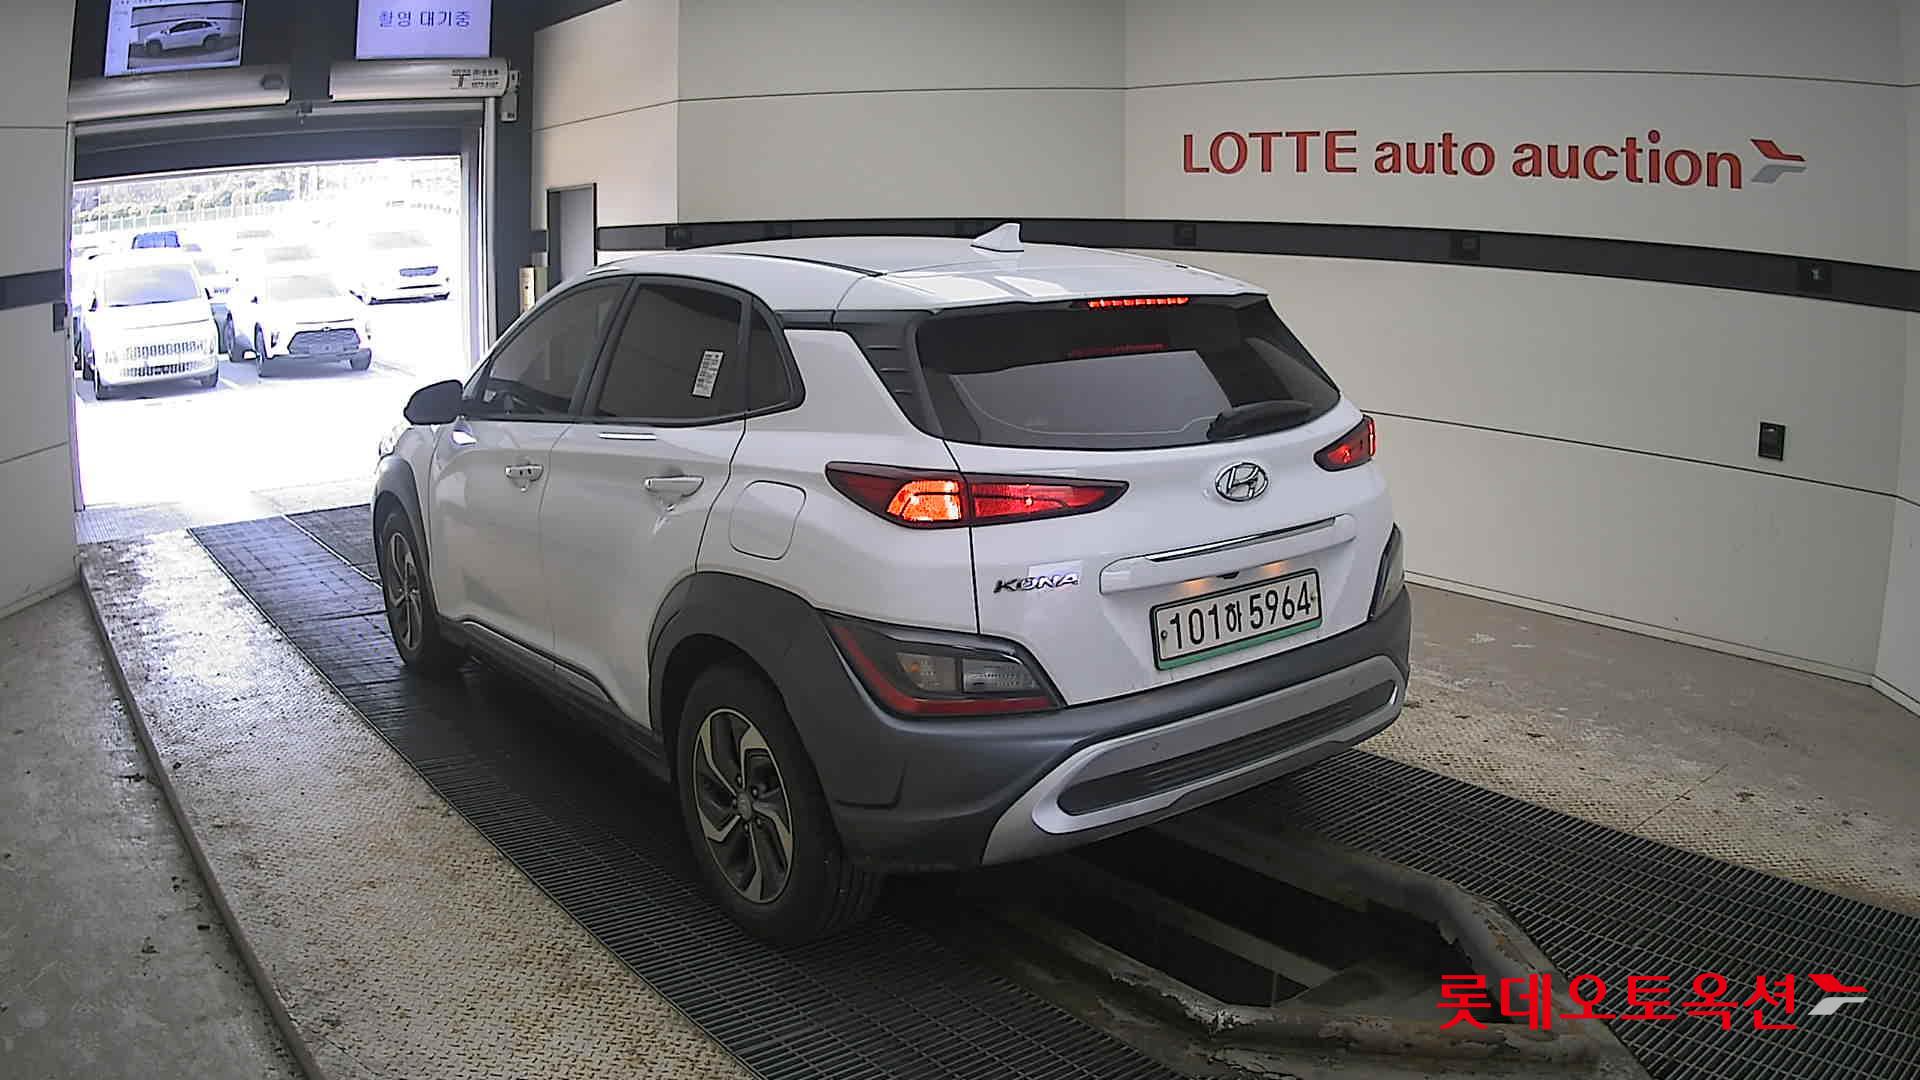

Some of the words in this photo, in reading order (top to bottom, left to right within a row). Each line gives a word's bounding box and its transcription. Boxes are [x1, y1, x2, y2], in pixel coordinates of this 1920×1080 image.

[420, 10, 472, 28] 대기중
[1183, 129, 1358, 174] LOTTE
[1374, 132, 1496, 177] auto
[1512, 129, 1743, 190] auction
[994, 573, 1079, 593] KONA
